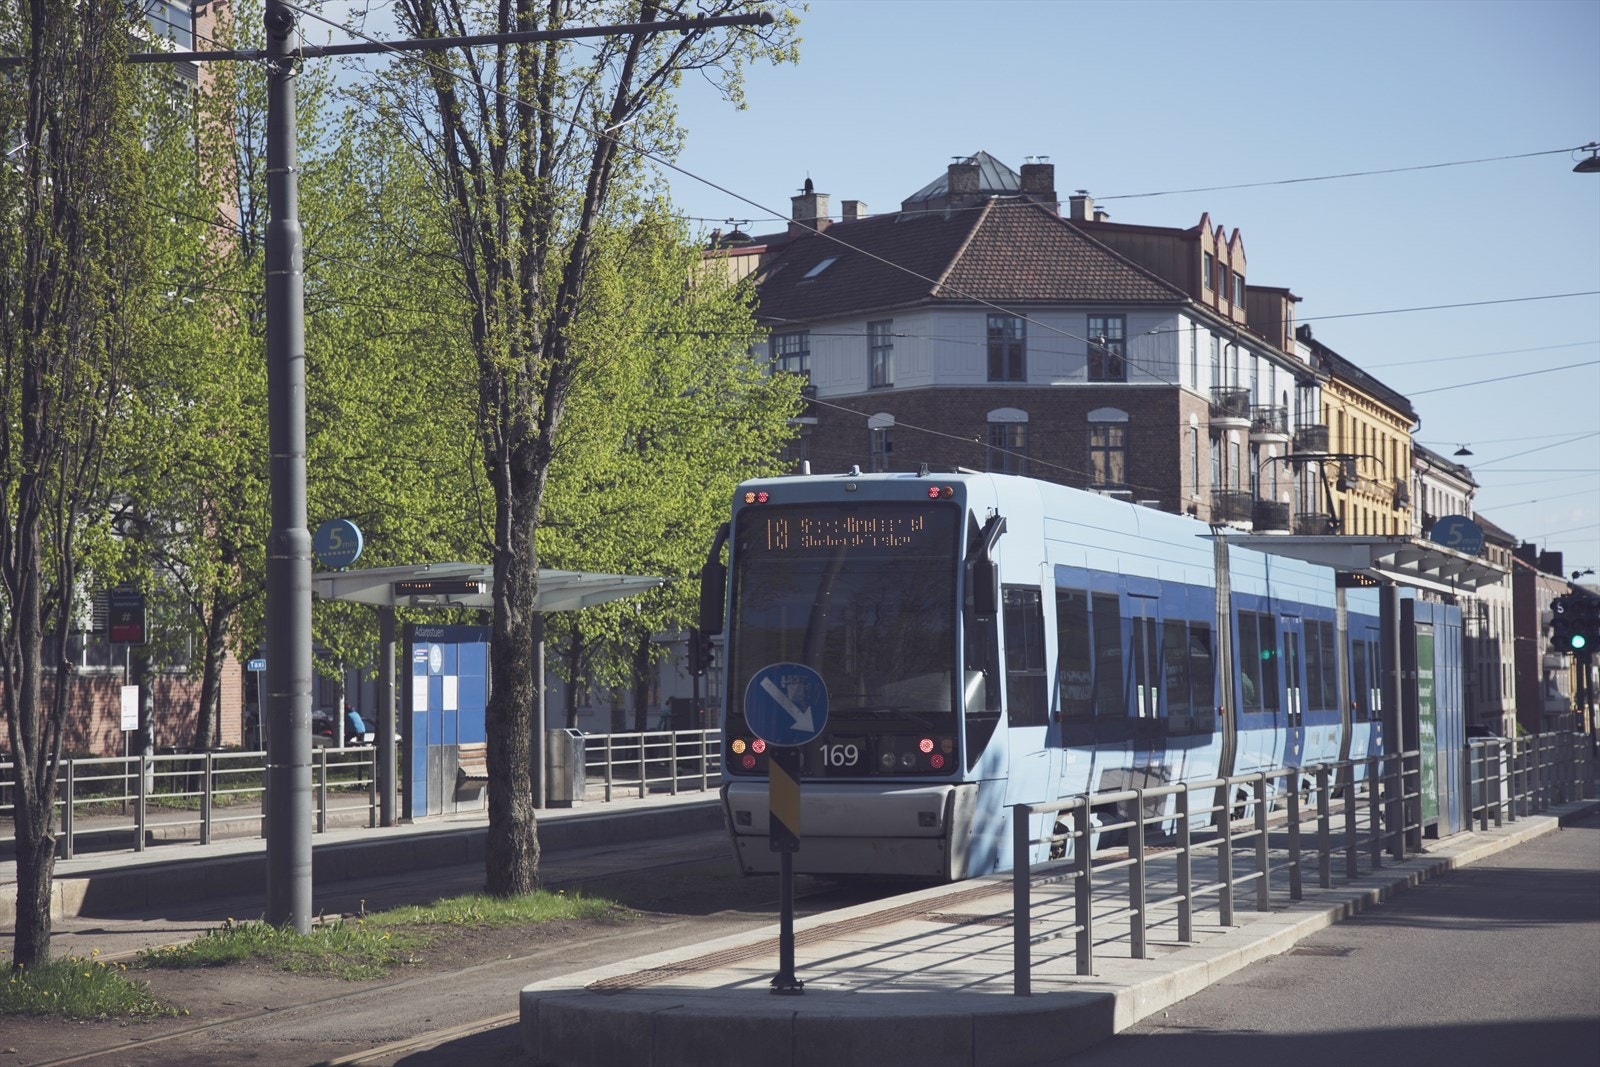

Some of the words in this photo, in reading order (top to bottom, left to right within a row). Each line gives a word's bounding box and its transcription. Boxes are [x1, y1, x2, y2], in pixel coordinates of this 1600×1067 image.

[328, 527, 343, 550] 5
[1447, 523, 1464, 545] 5
[1462, 537, 1479, 545] min
[1557, 602, 1564, 614] S
[819, 744, 859, 767] 169
